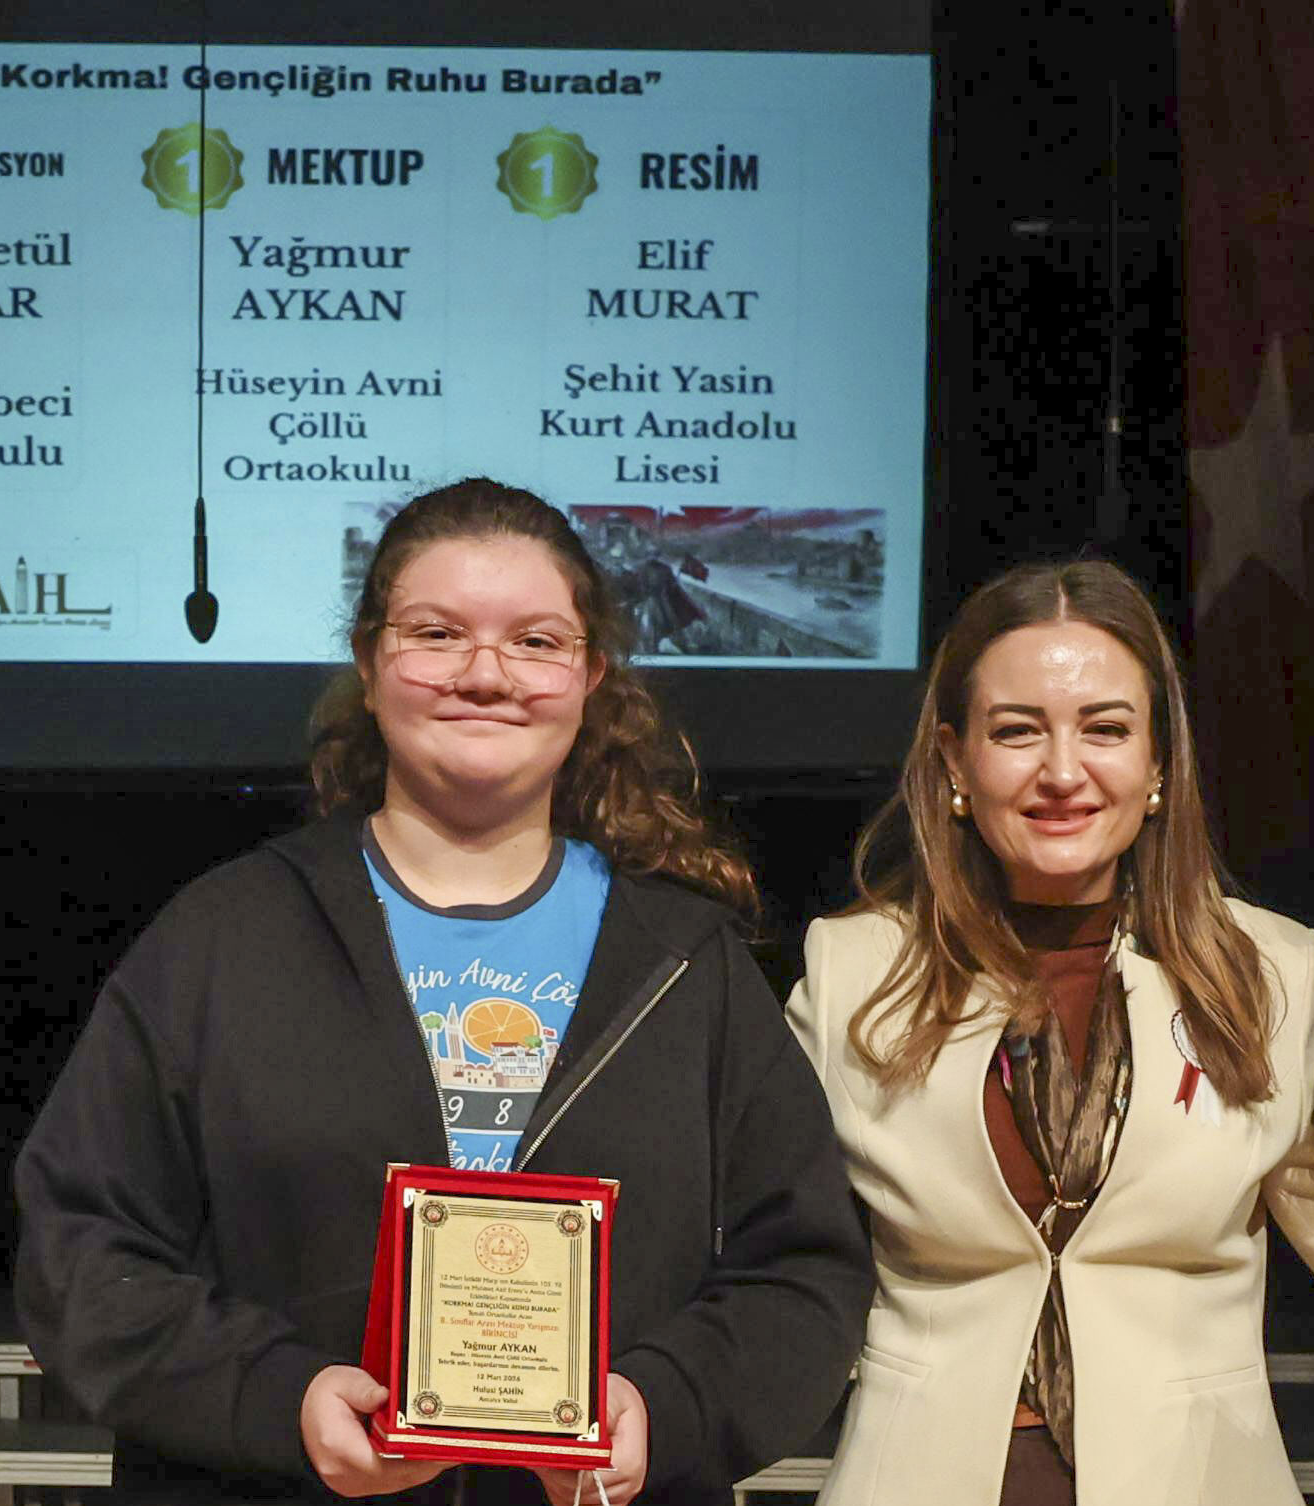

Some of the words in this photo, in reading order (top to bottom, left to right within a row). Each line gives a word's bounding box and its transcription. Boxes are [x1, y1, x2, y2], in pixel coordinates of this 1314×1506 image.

[183, 65, 371, 97] Gençliğin
[387, 67, 485, 92] Ruhu
[175, 150, 203, 193] 1
[268, 148, 424, 187] MEKTUP
[530, 153, 555, 198] 1
[641, 144, 759, 191] RESİM
[229, 235, 410, 276] Yağmur
[638, 240, 715, 271] Elif
[232, 289, 406, 321] AYKAN
[587, 290, 759, 320] MURAT
[195, 368, 345, 402] Hüseyin
[356, 369, 442, 396] Avni
[564, 364, 659, 399] Şehit
[673, 367, 773, 395] Yasin
[269, 412, 367, 444] Çöllü
[540, 410, 623, 438] Kurt
[636, 411, 797, 440] Anadolu
[224, 455, 411, 483] Ortaokulu
[615, 455, 720, 485] Lisesi
[459, 958, 528, 994] Avni
[448, 1095, 464, 1122] 9
[495, 1098, 514, 1125] 8
[462, 1340, 497, 1351] Yağmur
[500, 1343, 537, 1354] AYKAN
